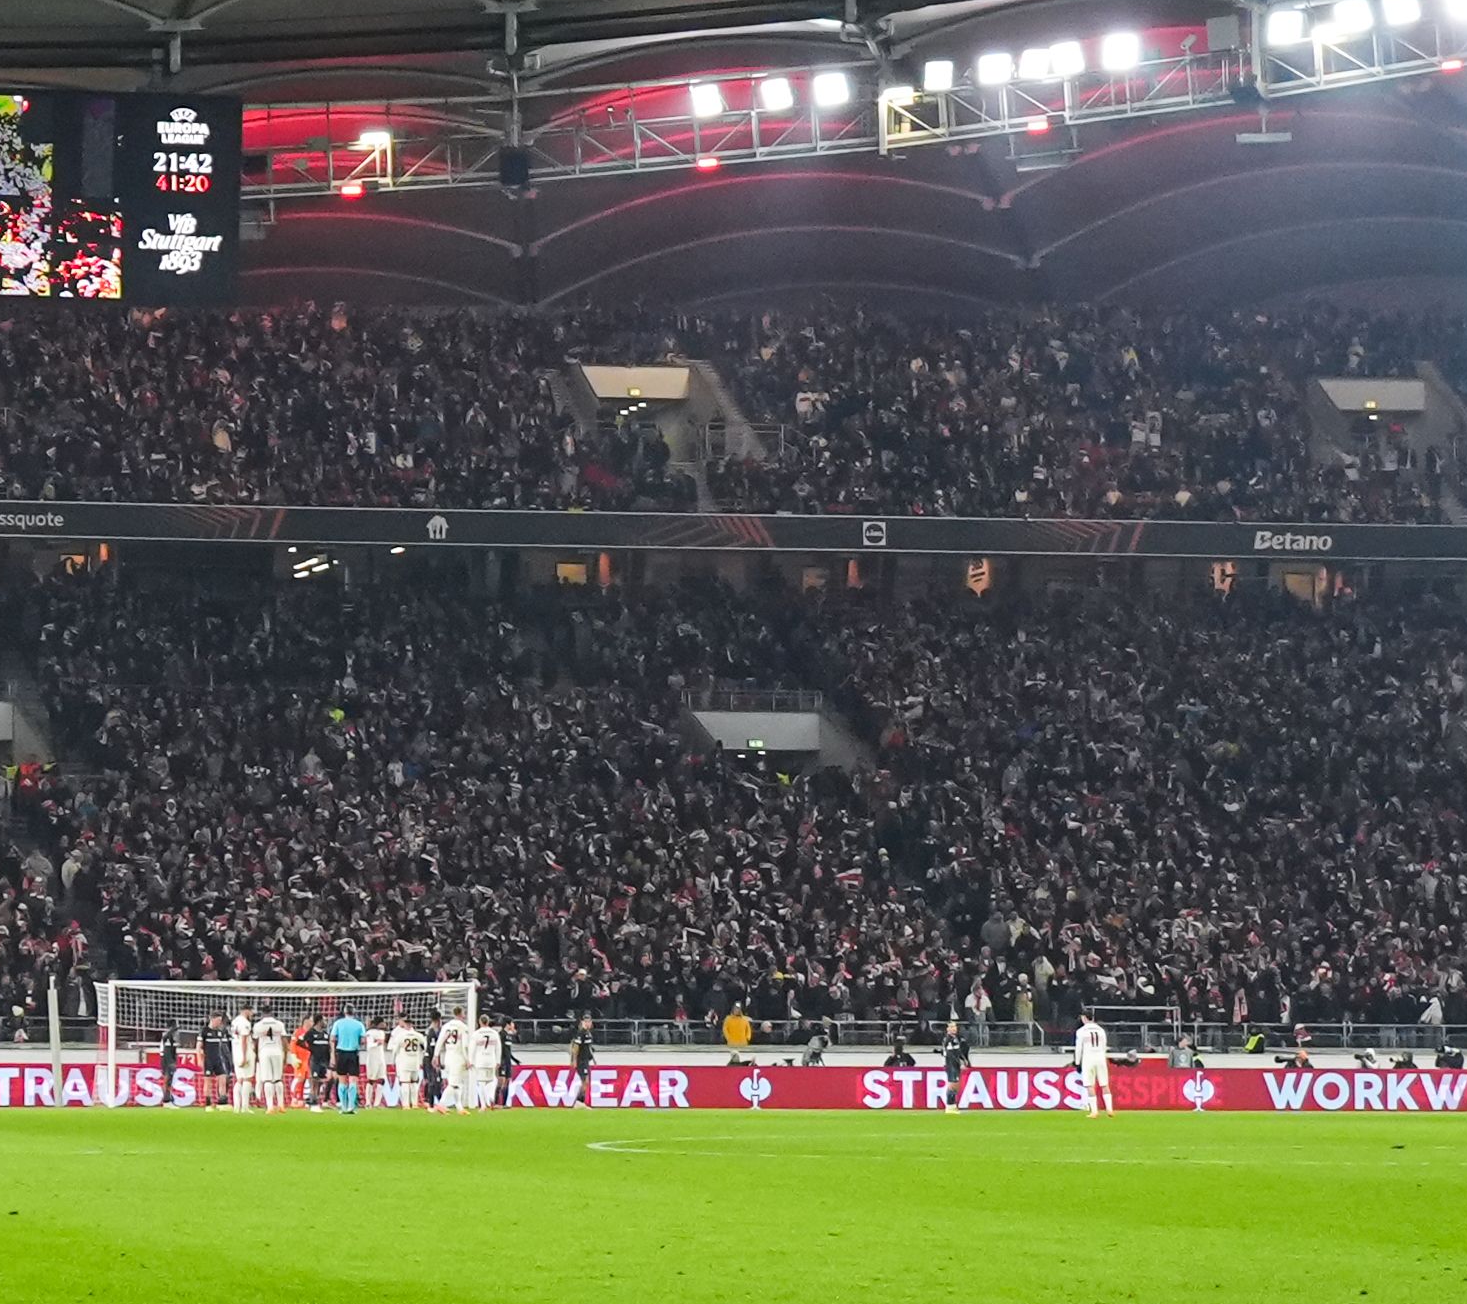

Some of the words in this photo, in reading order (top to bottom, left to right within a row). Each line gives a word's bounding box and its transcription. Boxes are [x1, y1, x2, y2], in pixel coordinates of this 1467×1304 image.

[157, 121, 210, 136] EUROPA
[161, 134, 206, 145] LEAGUE
[153, 152, 213, 173] 21:42
[156, 174, 210, 193] 41:20
[167, 213, 197, 235] VfB
[138, 229, 223, 255] Stuttgart
[159, 251, 203, 275] 1893
[1254, 531, 1333, 551] Betano
[267, 1026, 274, 1042] 4
[483, 1035, 490, 1050] 7
[1090, 1031, 1099, 1047] 11
[404, 1038, 419, 1052] 26
[862, 1070, 1088, 1110] STRAUSS
